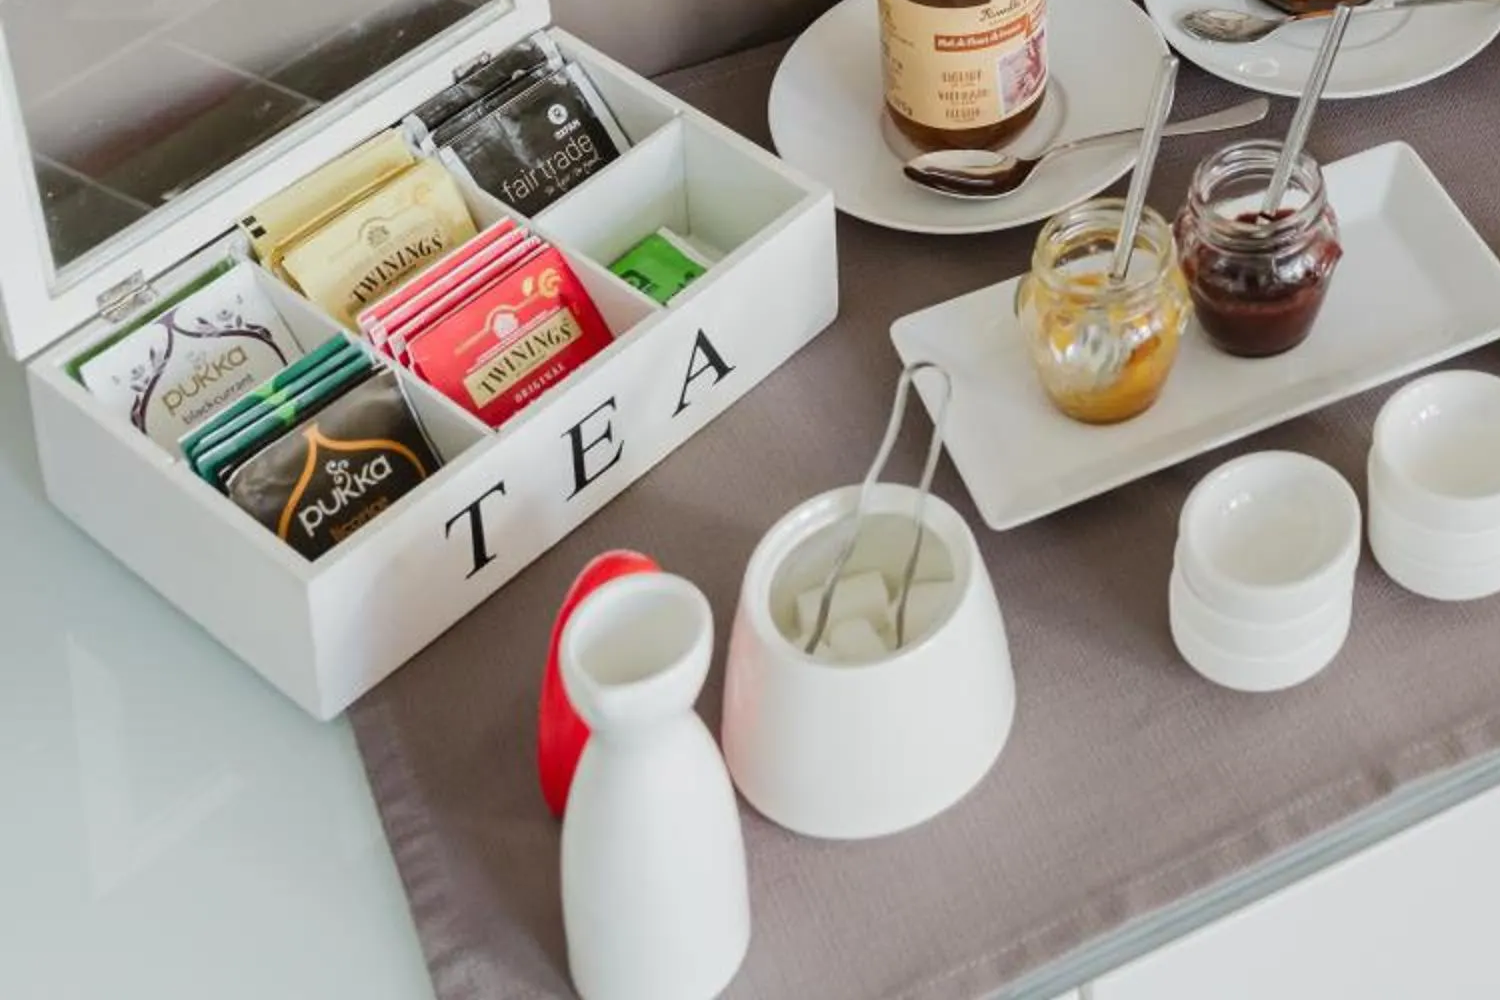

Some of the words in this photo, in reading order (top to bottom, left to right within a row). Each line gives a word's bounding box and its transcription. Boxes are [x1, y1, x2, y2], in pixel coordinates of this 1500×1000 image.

[350, 230, 444, 305] TWININGS
[161, 344, 248, 417] pukka
[476, 319, 574, 397] TWININGS
[514, 362, 565, 405] ORIGINAL
[445, 327, 737, 580] TEA
[297, 454, 393, 538] pukka
